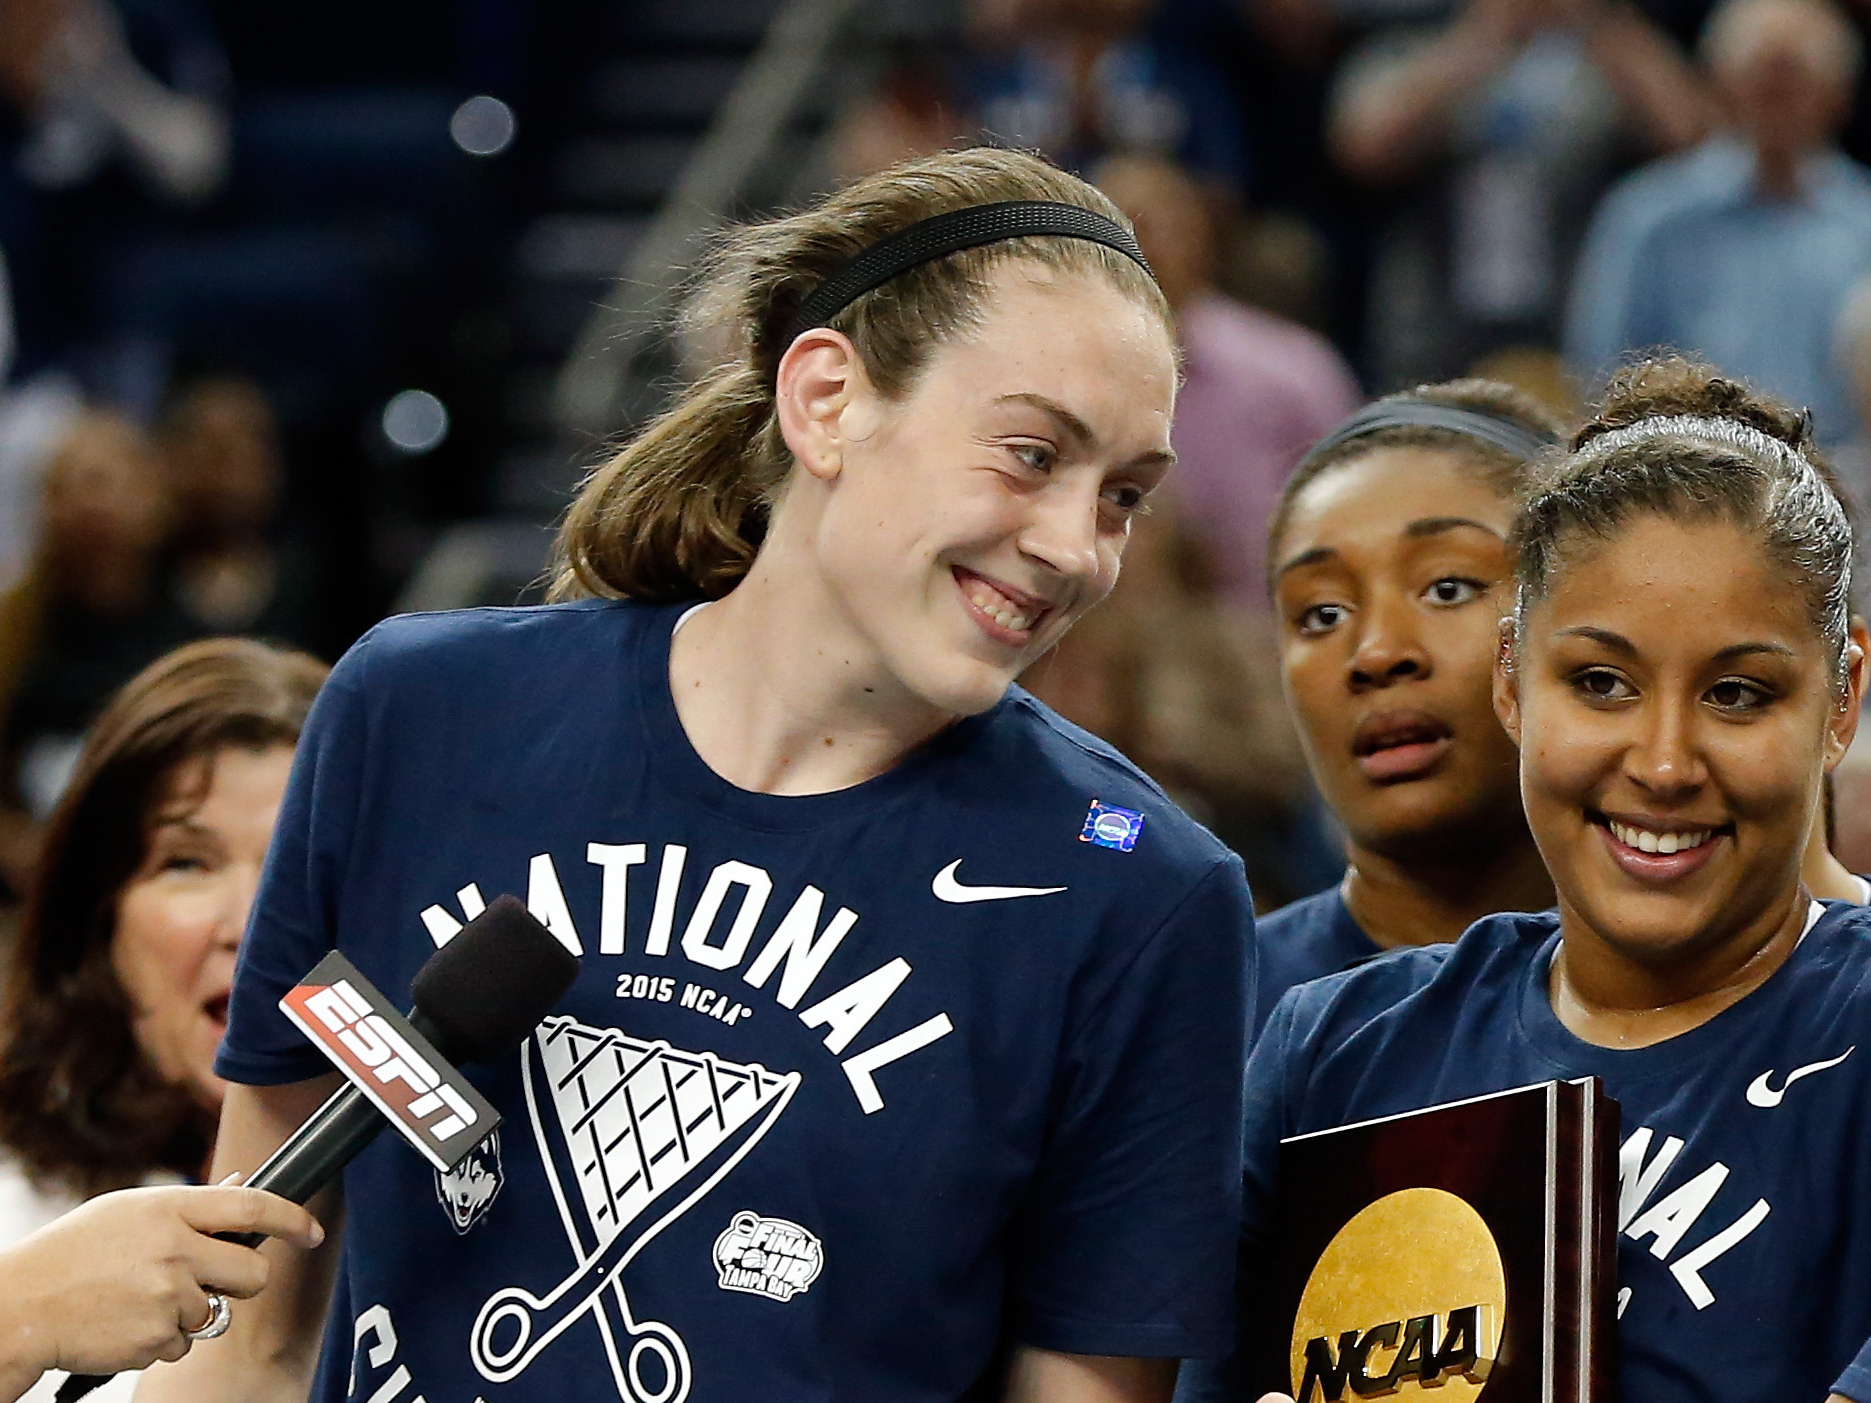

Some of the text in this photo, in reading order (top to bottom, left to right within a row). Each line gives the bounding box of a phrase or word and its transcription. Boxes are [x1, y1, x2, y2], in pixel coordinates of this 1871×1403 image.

[616, 974, 677, 1003] 2015
[303, 978, 479, 1143] ESPN
[749, 1222, 818, 1262] FINAL
[723, 1264, 793, 1298] TAMPA BAY
